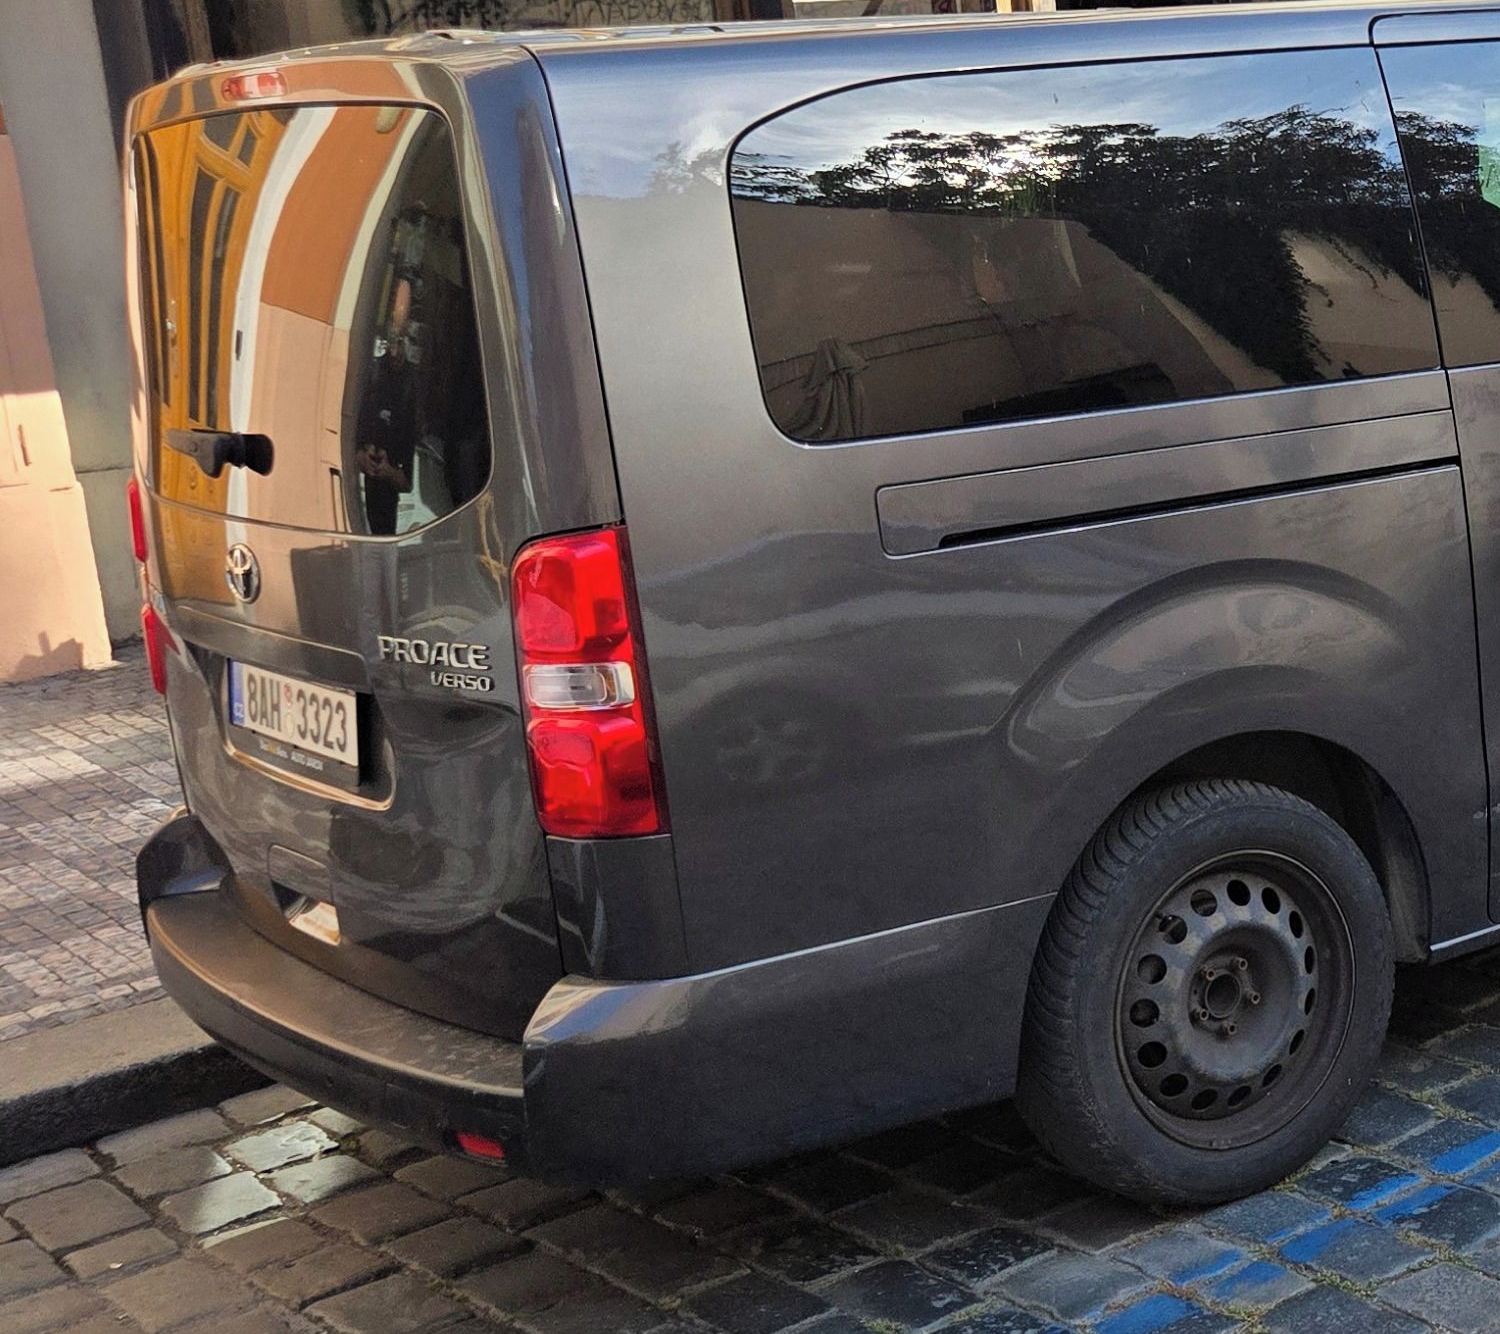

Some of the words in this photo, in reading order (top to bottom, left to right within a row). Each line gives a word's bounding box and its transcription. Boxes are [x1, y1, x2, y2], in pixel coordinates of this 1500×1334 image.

[377, 635, 491, 670] PROACE
[431, 671, 495, 692] VERSO
[247, 672, 281, 733] 8AH
[296, 688, 347, 754] 3323
